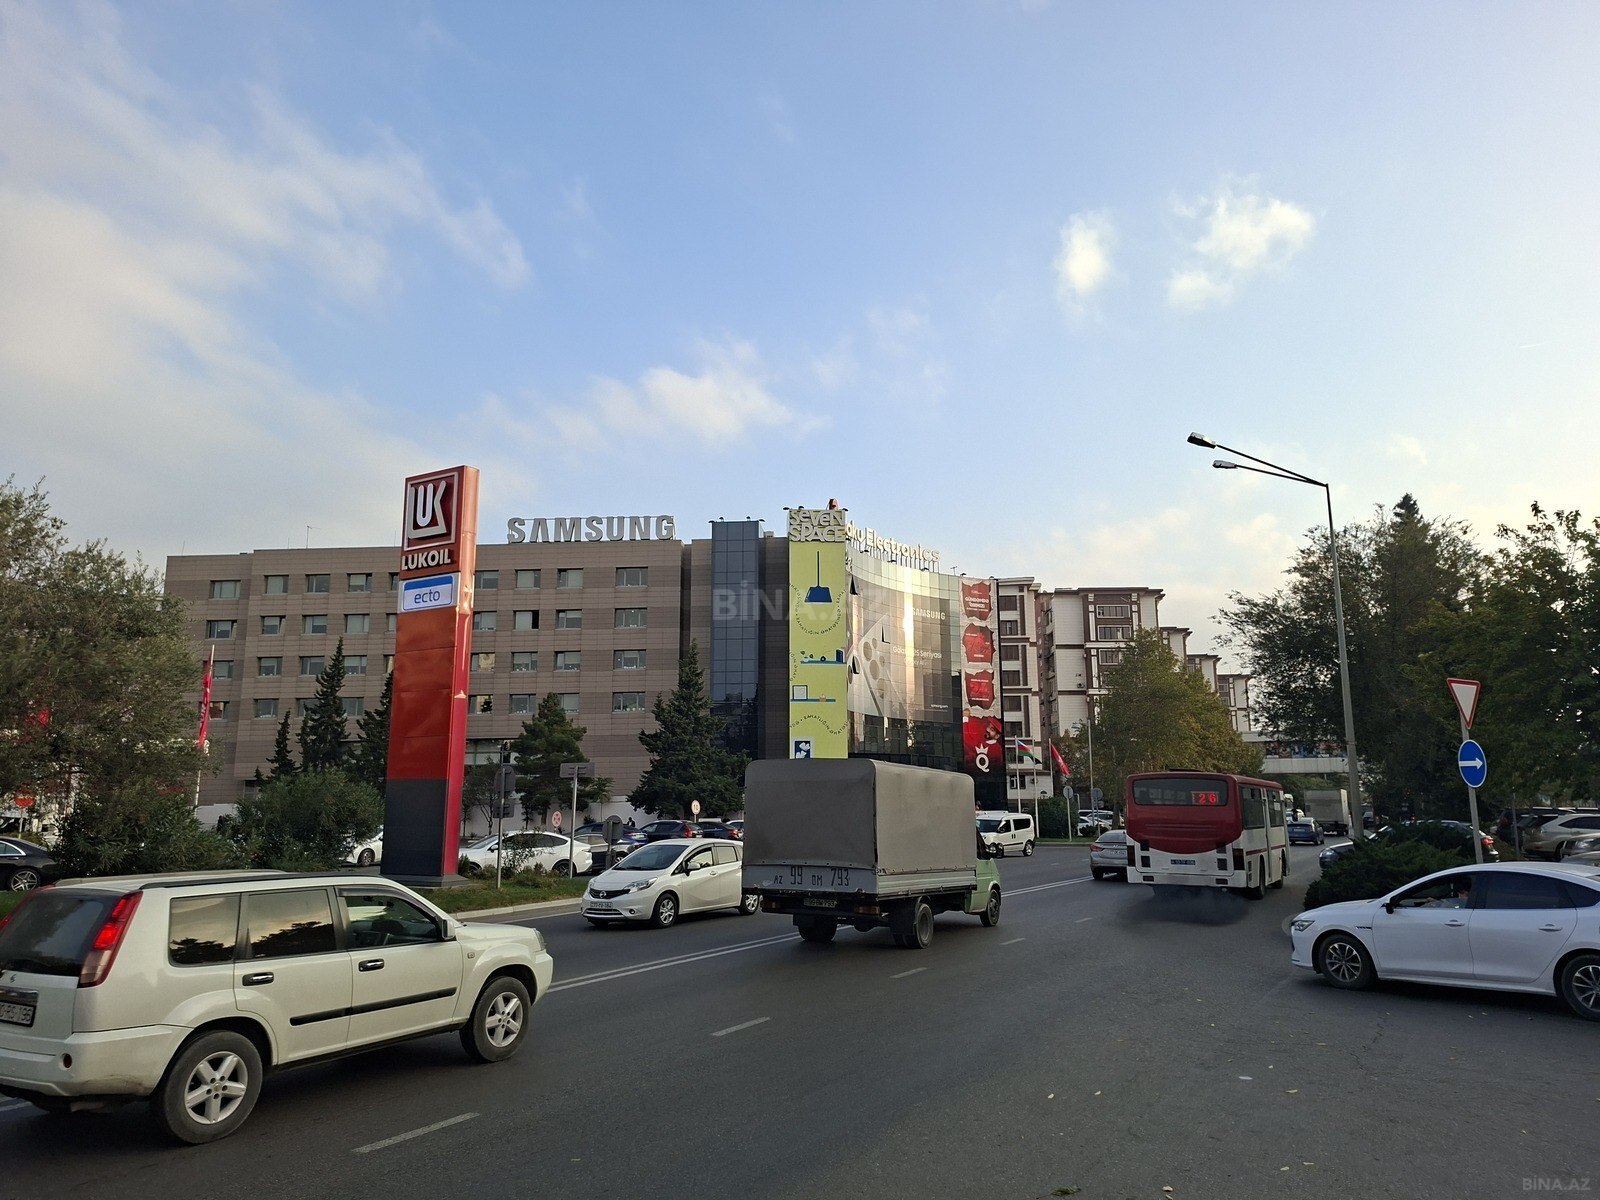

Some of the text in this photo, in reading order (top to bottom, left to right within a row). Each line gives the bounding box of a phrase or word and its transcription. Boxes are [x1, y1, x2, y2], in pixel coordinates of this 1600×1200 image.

[507, 515, 675, 543] SAMSUNG
[789, 522, 846, 542] SPACE
[866, 527, 941, 562] Electronics
[401, 548, 451, 571] LUKOIL
[413, 589, 441, 604] ecto
[912, 607, 946, 620] SAMSUNG
[975, 753, 990, 773] Q
[1198, 793, 1216, 805] 26
[773, 875, 783, 885] AZ
[790, 866, 803, 885] 99
[830, 868, 850, 887] 793
